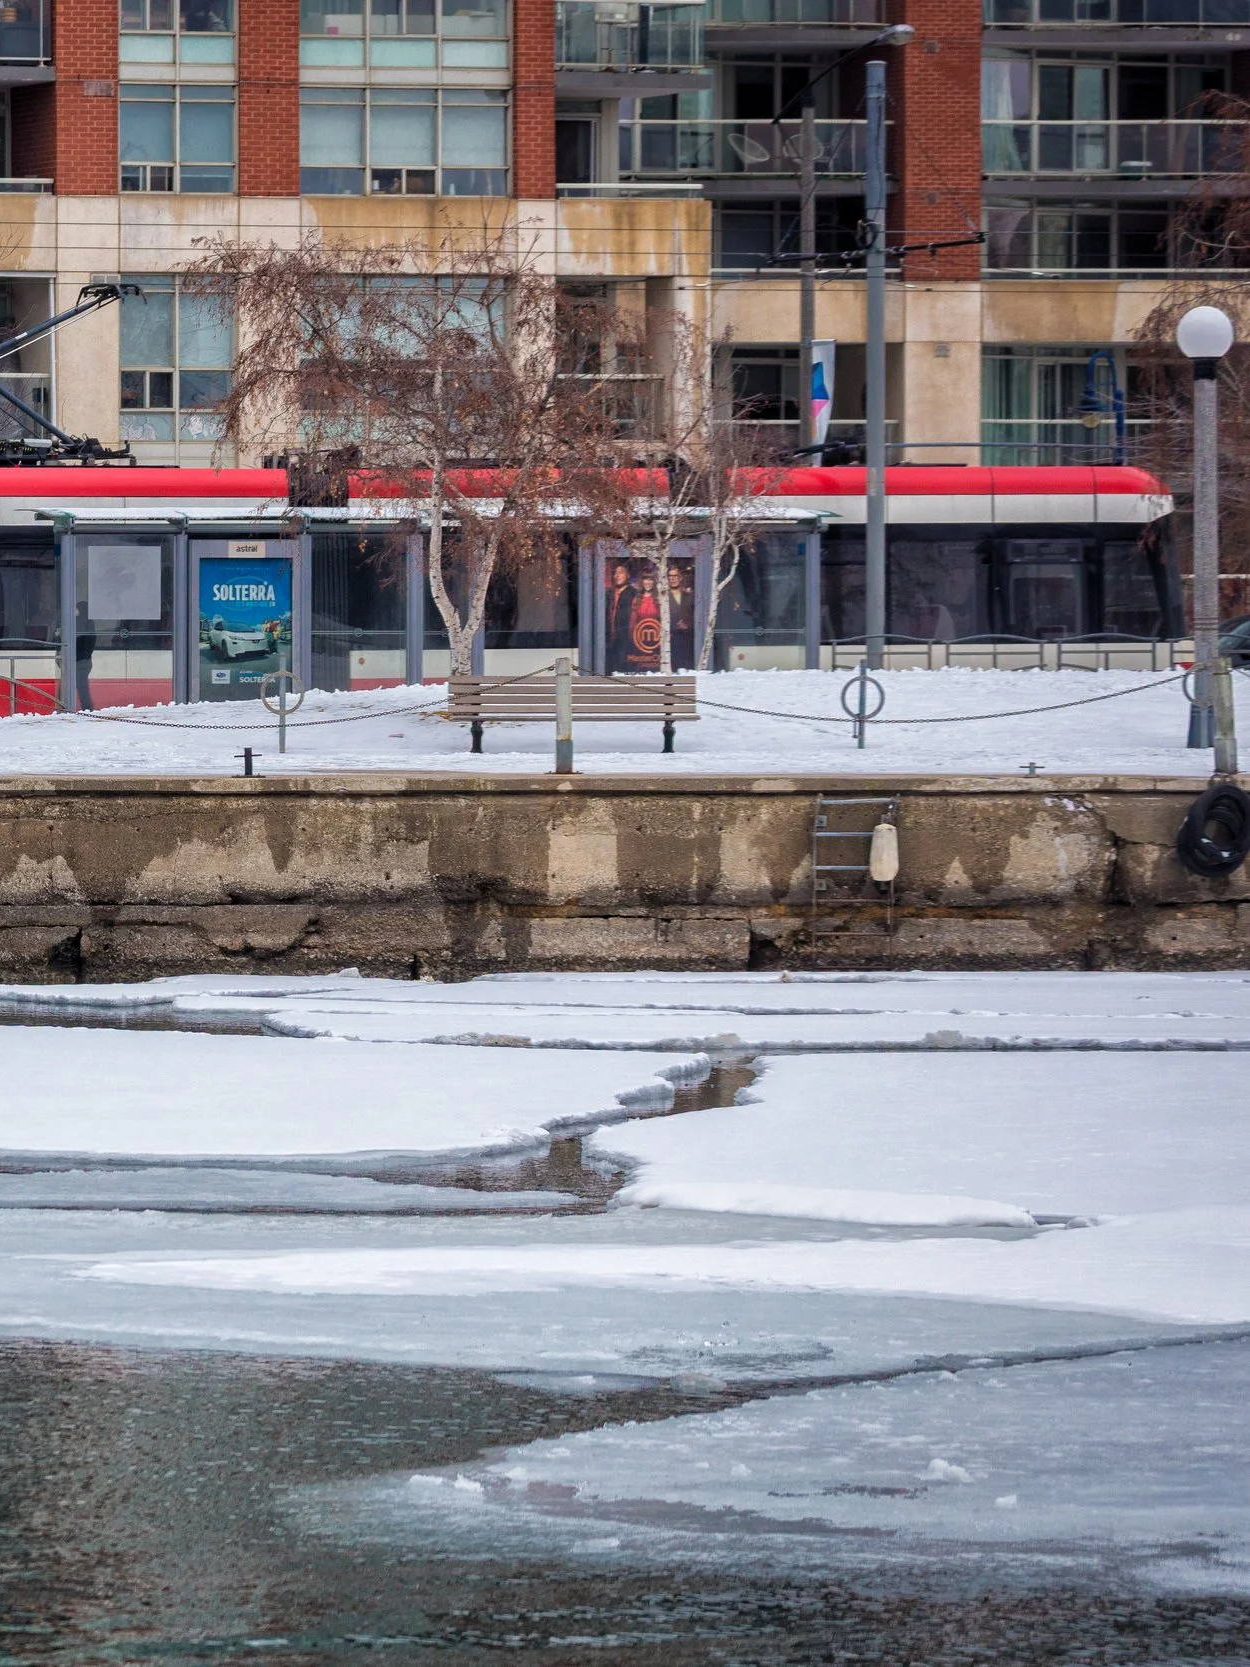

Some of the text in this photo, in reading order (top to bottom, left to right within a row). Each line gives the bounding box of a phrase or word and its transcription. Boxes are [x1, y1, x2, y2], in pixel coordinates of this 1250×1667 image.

[236, 544, 258, 553] astral
[212, 584, 275, 601] SOLTERRA
[626, 654, 661, 662] MasterC
[239, 676, 276, 684] SOLTERA
